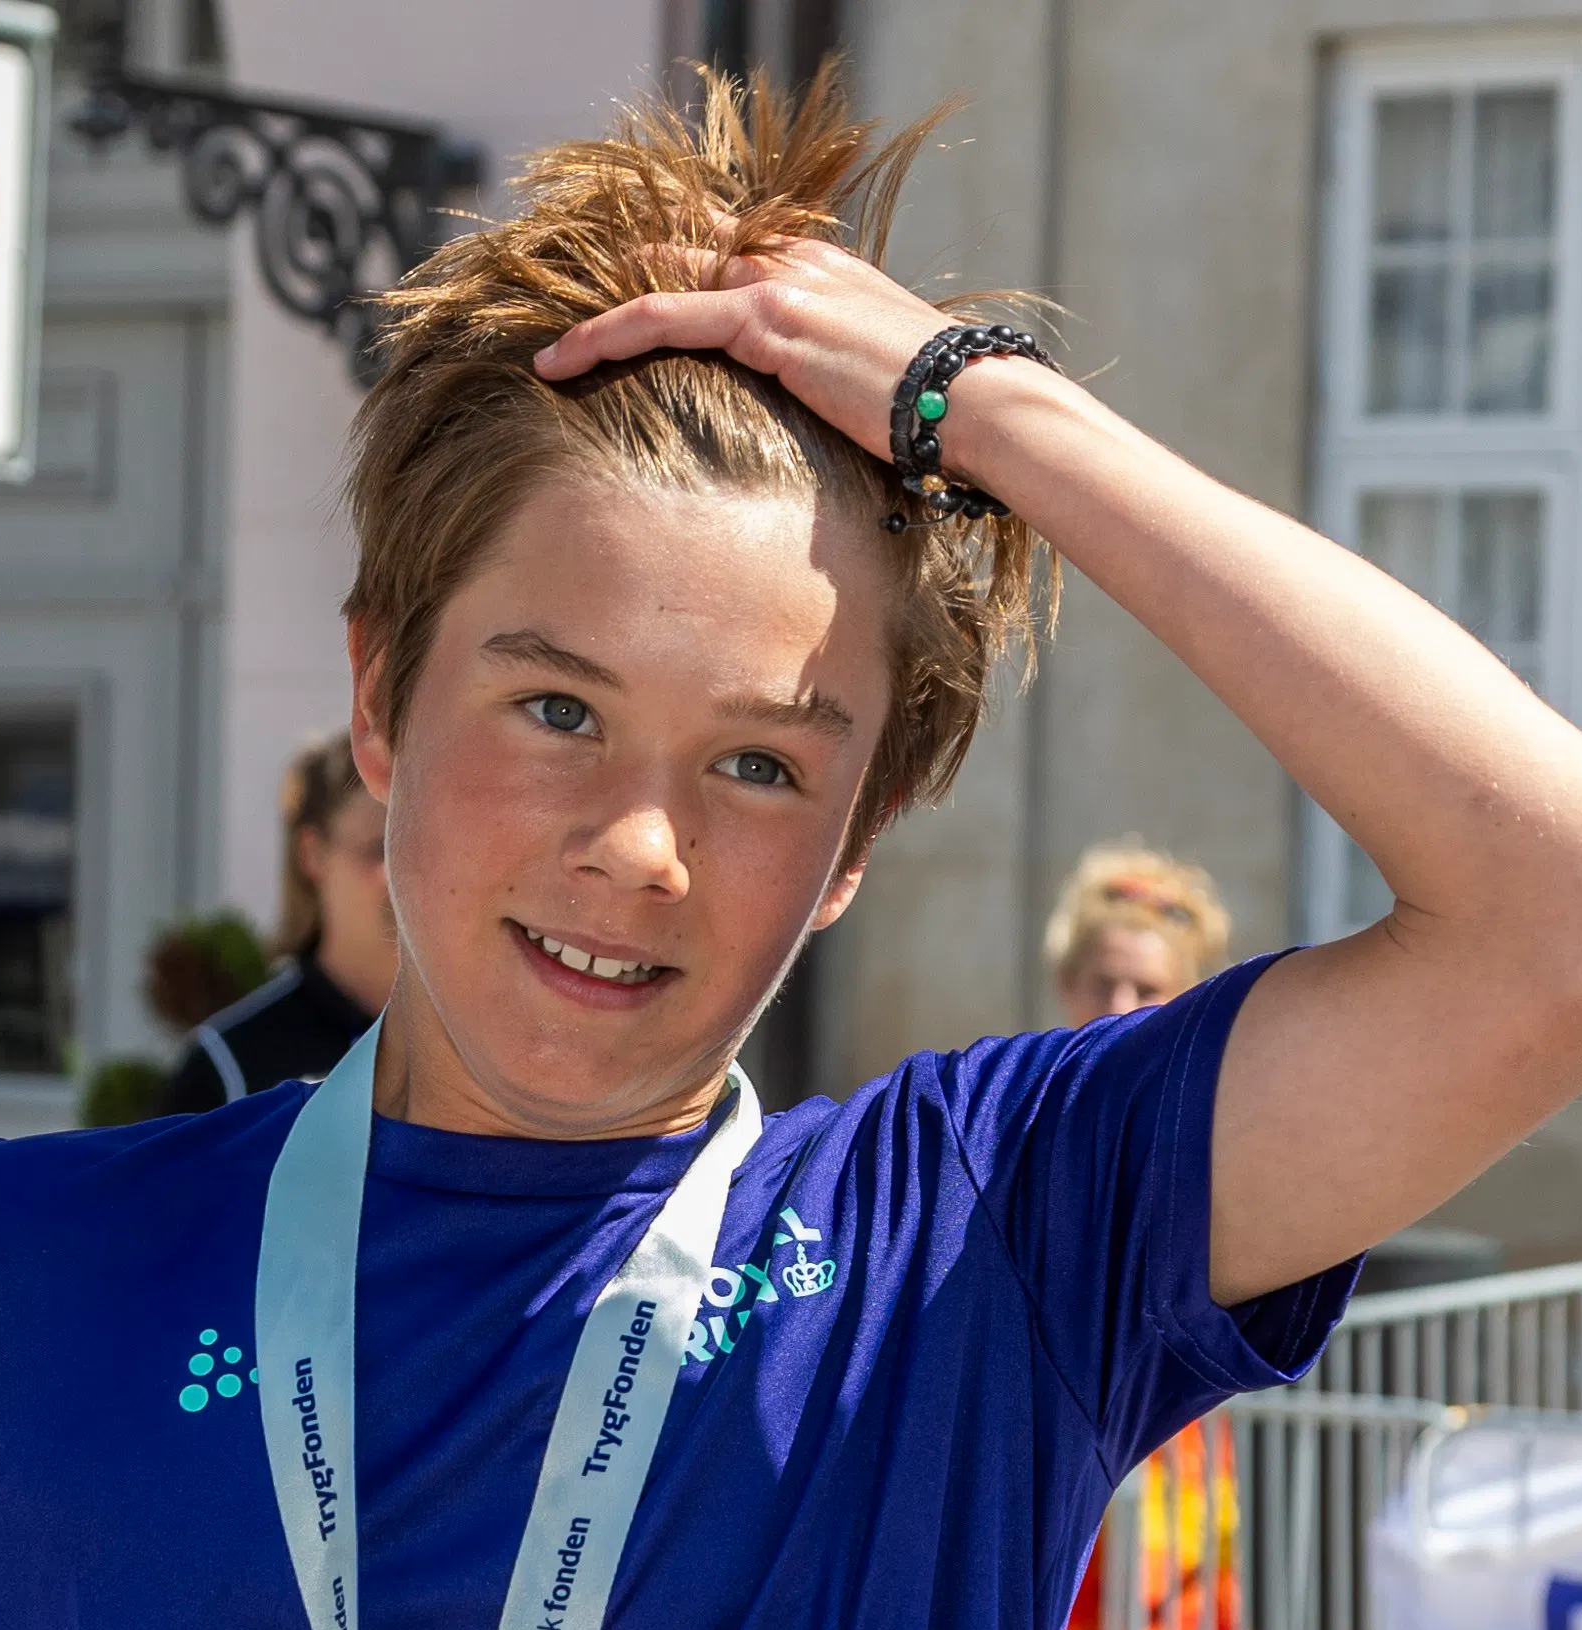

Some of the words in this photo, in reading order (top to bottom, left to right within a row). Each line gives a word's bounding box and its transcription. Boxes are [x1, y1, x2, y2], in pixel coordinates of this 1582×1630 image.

[292, 1356, 337, 1542] TrygFonden
[582, 1299, 657, 1478] TrygFonden
[544, 1517, 591, 1612] fonden
